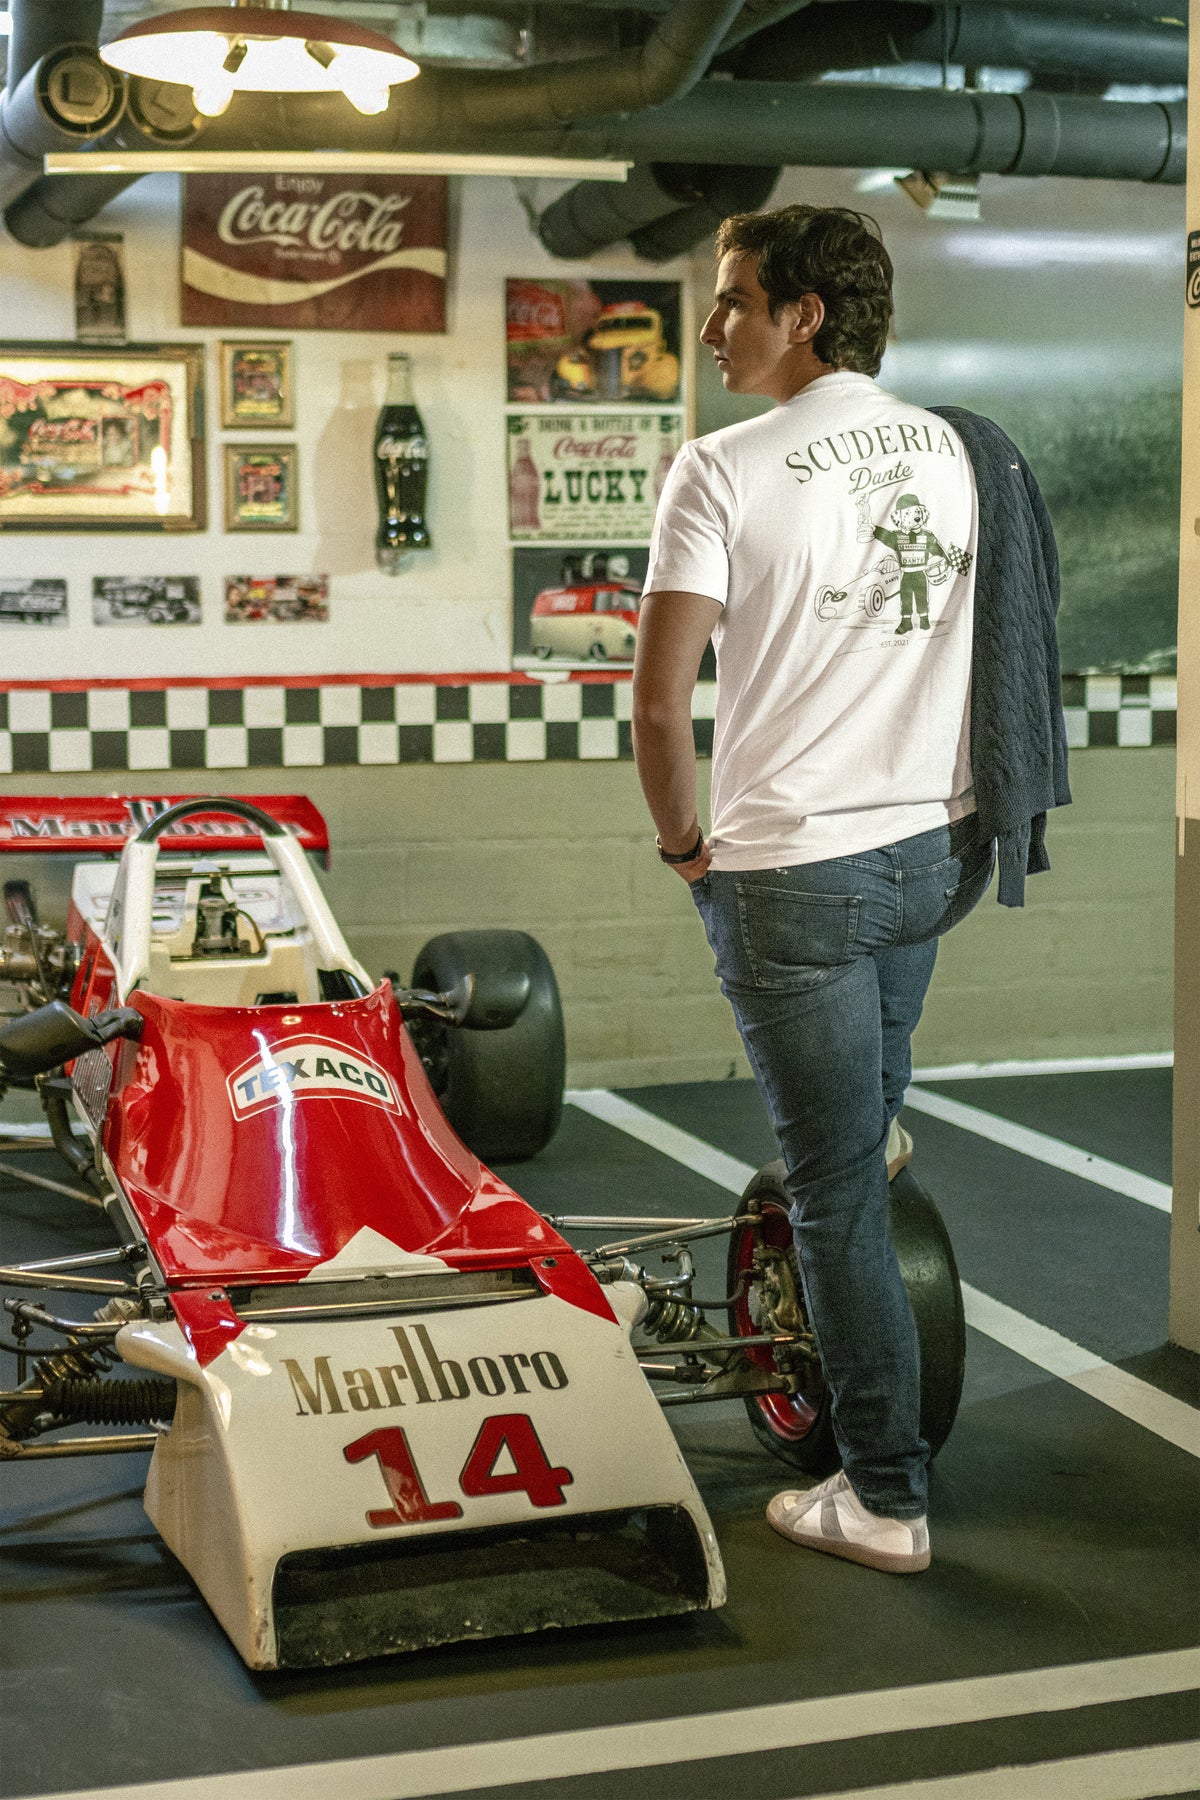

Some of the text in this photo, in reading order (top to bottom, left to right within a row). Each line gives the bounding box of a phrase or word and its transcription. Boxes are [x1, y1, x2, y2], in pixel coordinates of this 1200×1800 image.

[274, 174, 325, 194] Enjoy
[217, 184, 413, 252] Coca-Cola
[785, 423, 956, 484] SCUDERIA
[849, 461, 914, 495] Dante
[543, 469, 648, 504] LUCKY
[237, 1057, 388, 1102] TEXACO
[280, 1324, 570, 1416] Marlboro
[343, 1413, 574, 1529] 14
